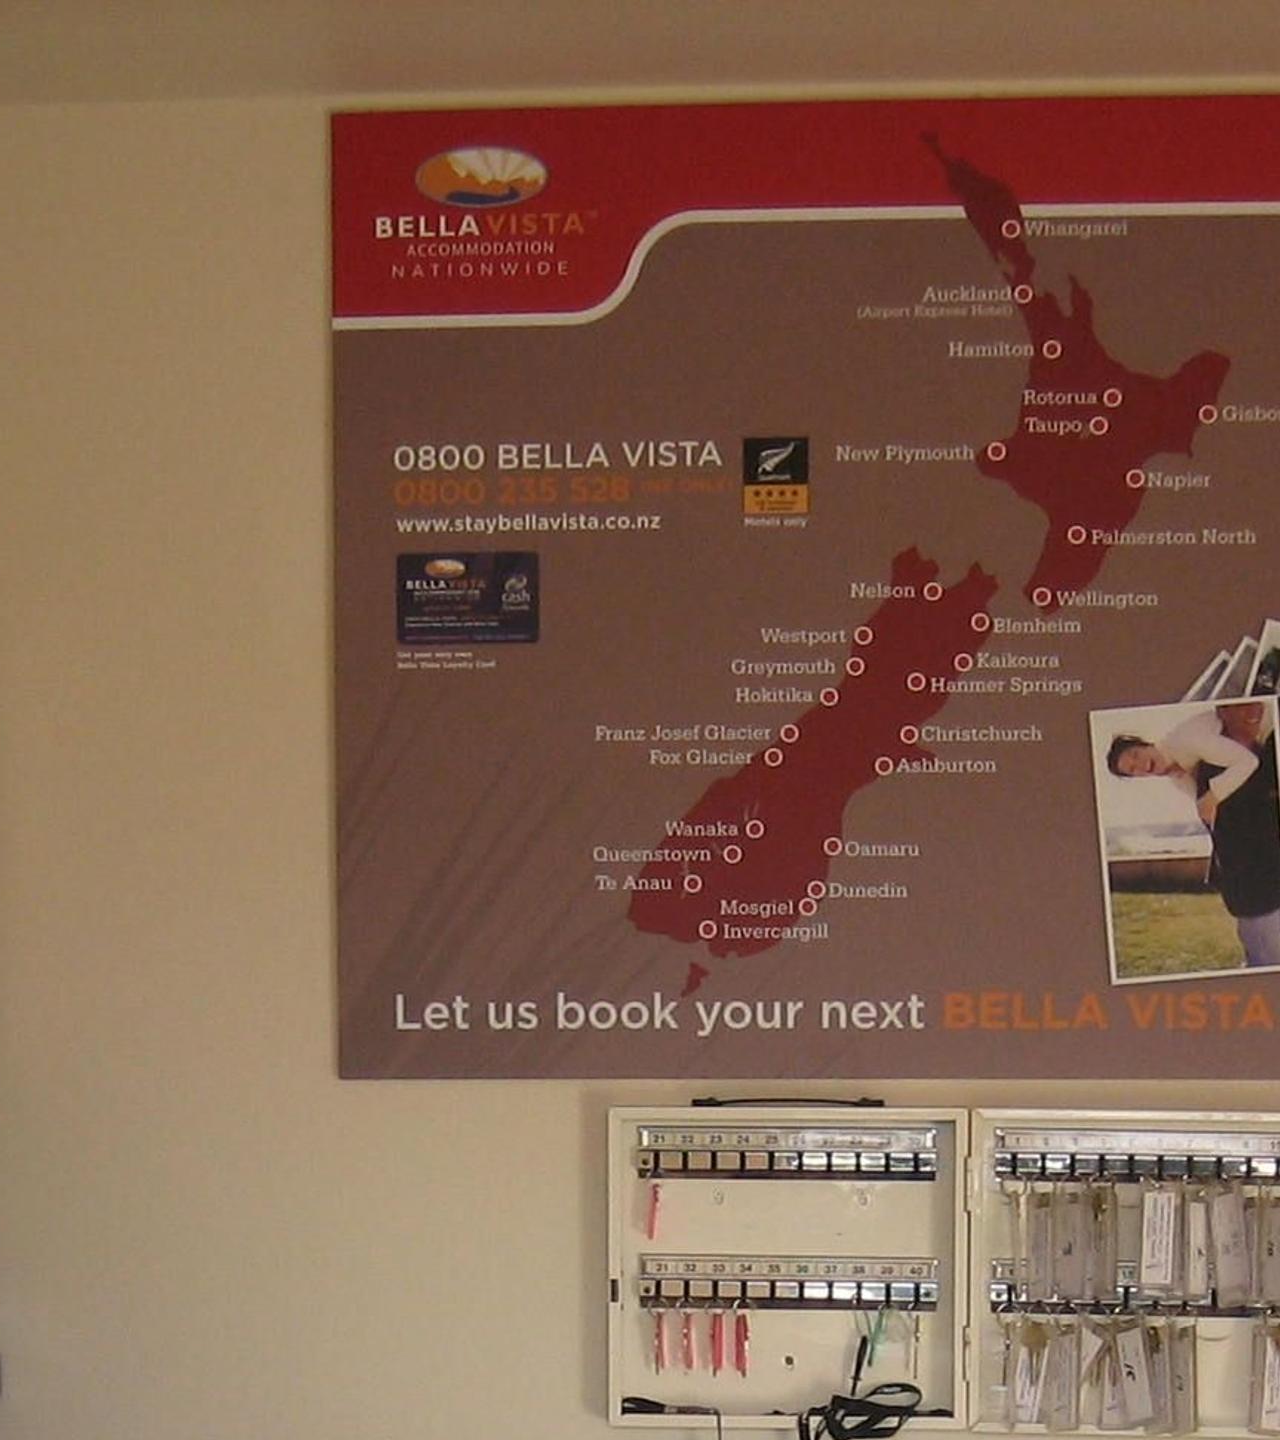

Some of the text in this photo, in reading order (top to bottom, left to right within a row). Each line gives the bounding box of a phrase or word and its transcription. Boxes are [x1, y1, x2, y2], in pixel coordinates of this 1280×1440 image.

[375, 213, 585, 238] BELLA VISTA
[1024, 221, 1128, 237] Whangarei
[406, 241, 555, 257] ACCOMMODATION
[391, 261, 569, 279] NATIONWIDE
[923, 286, 1012, 303] Auckland
[948, 342, 1034, 357] Hamilton
[1023, 389, 1097, 405] Rotorua
[1024, 418, 1082, 436] Taupo
[394, 441, 722, 471] 0800 BELLA VISTA
[835, 445, 974, 466] New Plymouth
[1148, 472, 1211, 490] Napier
[394, 479, 486, 506] 0800
[500, 477, 558, 505] 235
[396, 513, 662, 535] www.staybellavista.co.nz
[1091, 529, 1257, 545] Palmerston North
[850, 583, 916, 598] Nelson
[1056, 590, 1158, 609] Wellington
[994, 618, 1081, 634] Blenheim
[761, 628, 846, 646] Westport
[731, 659, 836, 677] Greymouth
[977, 653, 1059, 668] Kaikoura
[735, 687, 813, 703] Hokitika
[931, 678, 1082, 695] Hanmer Springs
[595, 725, 771, 741] Franz Josef Glacier
[921, 725, 1043, 742] Christchurch
[650, 749, 754, 765] Fox Glacier
[896, 757, 997, 773] Ashburton
[665, 821, 739, 836] Wanaka
[593, 846, 712, 864] Queenstown
[845, 842, 920, 857] Oamaru
[595, 876, 673, 890] Te Anau
[828, 883, 908, 898] Dunedin
[720, 900, 794, 918] Mosgiel
[723, 924, 828, 943] Invercargill
[394, 993, 470, 1031] Let
[487, 1000, 540, 1031] us
[556, 992, 677, 1031] book
[696, 1000, 804, 1037] your
[821, 994, 926, 1031] next
[943, 992, 1110, 1030] BELLA
[1128, 992, 1275, 1030] VISTA
